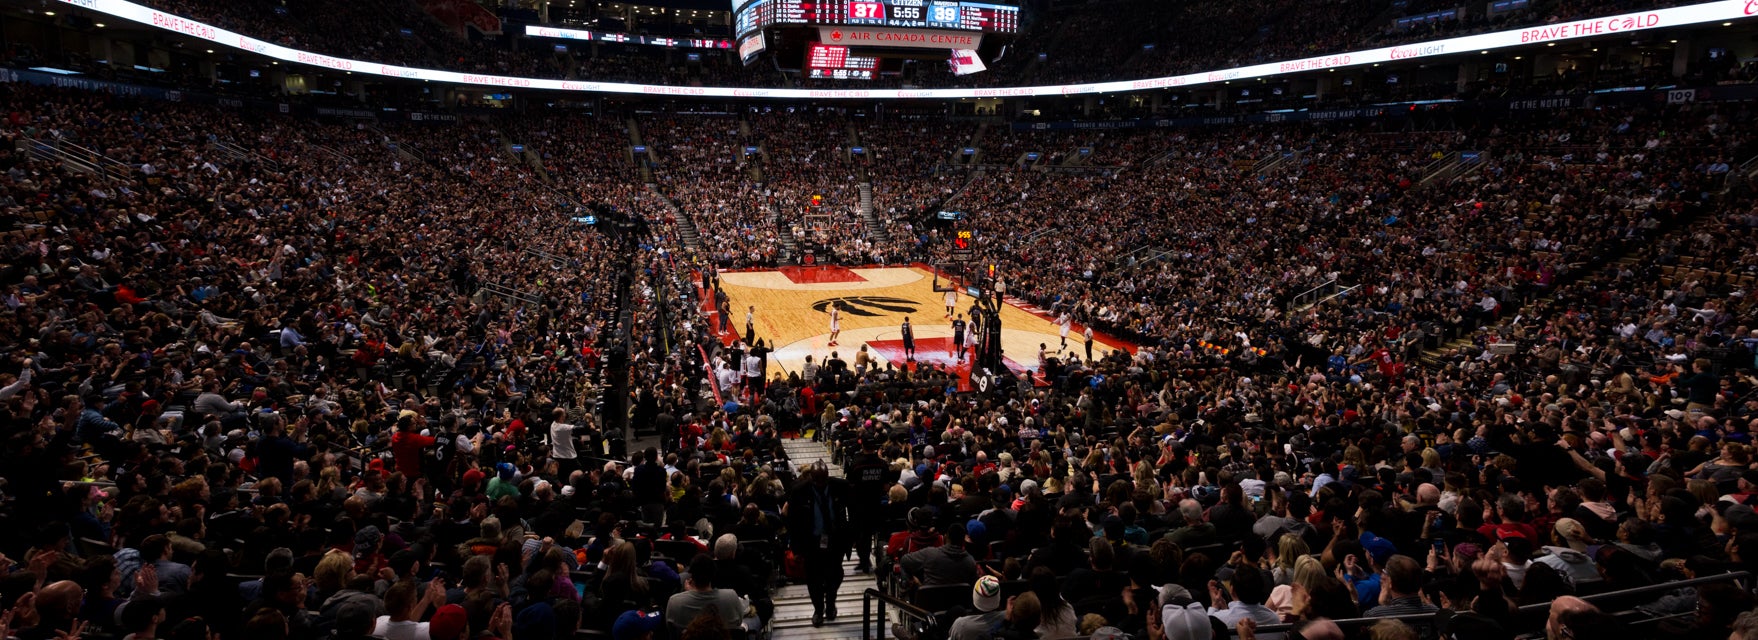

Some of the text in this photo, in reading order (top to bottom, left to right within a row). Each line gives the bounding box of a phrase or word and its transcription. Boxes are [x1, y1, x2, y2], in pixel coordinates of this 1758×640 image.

[854, 4, 877, 17] 37
[894, 7, 919, 18] 5:55
[935, 7, 955, 21] 39
[153, 13, 178, 30] BRAVE
[180, 20, 195, 34] THE
[850, 32, 972, 44] AIR CANADA CENTRE
[1522, 26, 1568, 42] BRAVE
[1574, 21, 1604, 36] THE
[1390, 45, 1445, 59] Coors LIGHT
[298, 52, 318, 64] BRAVE
[319, 57, 331, 66] THE
[1280, 60, 1305, 73] BRAVE
[1307, 59, 1323, 69] THE
[52, 77, 88, 90] TORONTO
[463, 75, 488, 84] BRAVE
[491, 77, 505, 85] THE
[1133, 81, 1152, 89] BRAVE
[1670, 92, 1691, 101] 109
[1521, 99, 1537, 109] THE
[1540, 98, 1570, 108] NORTH
[1309, 111, 1337, 119] TORONTO
[436, 445, 443, 460] 6
